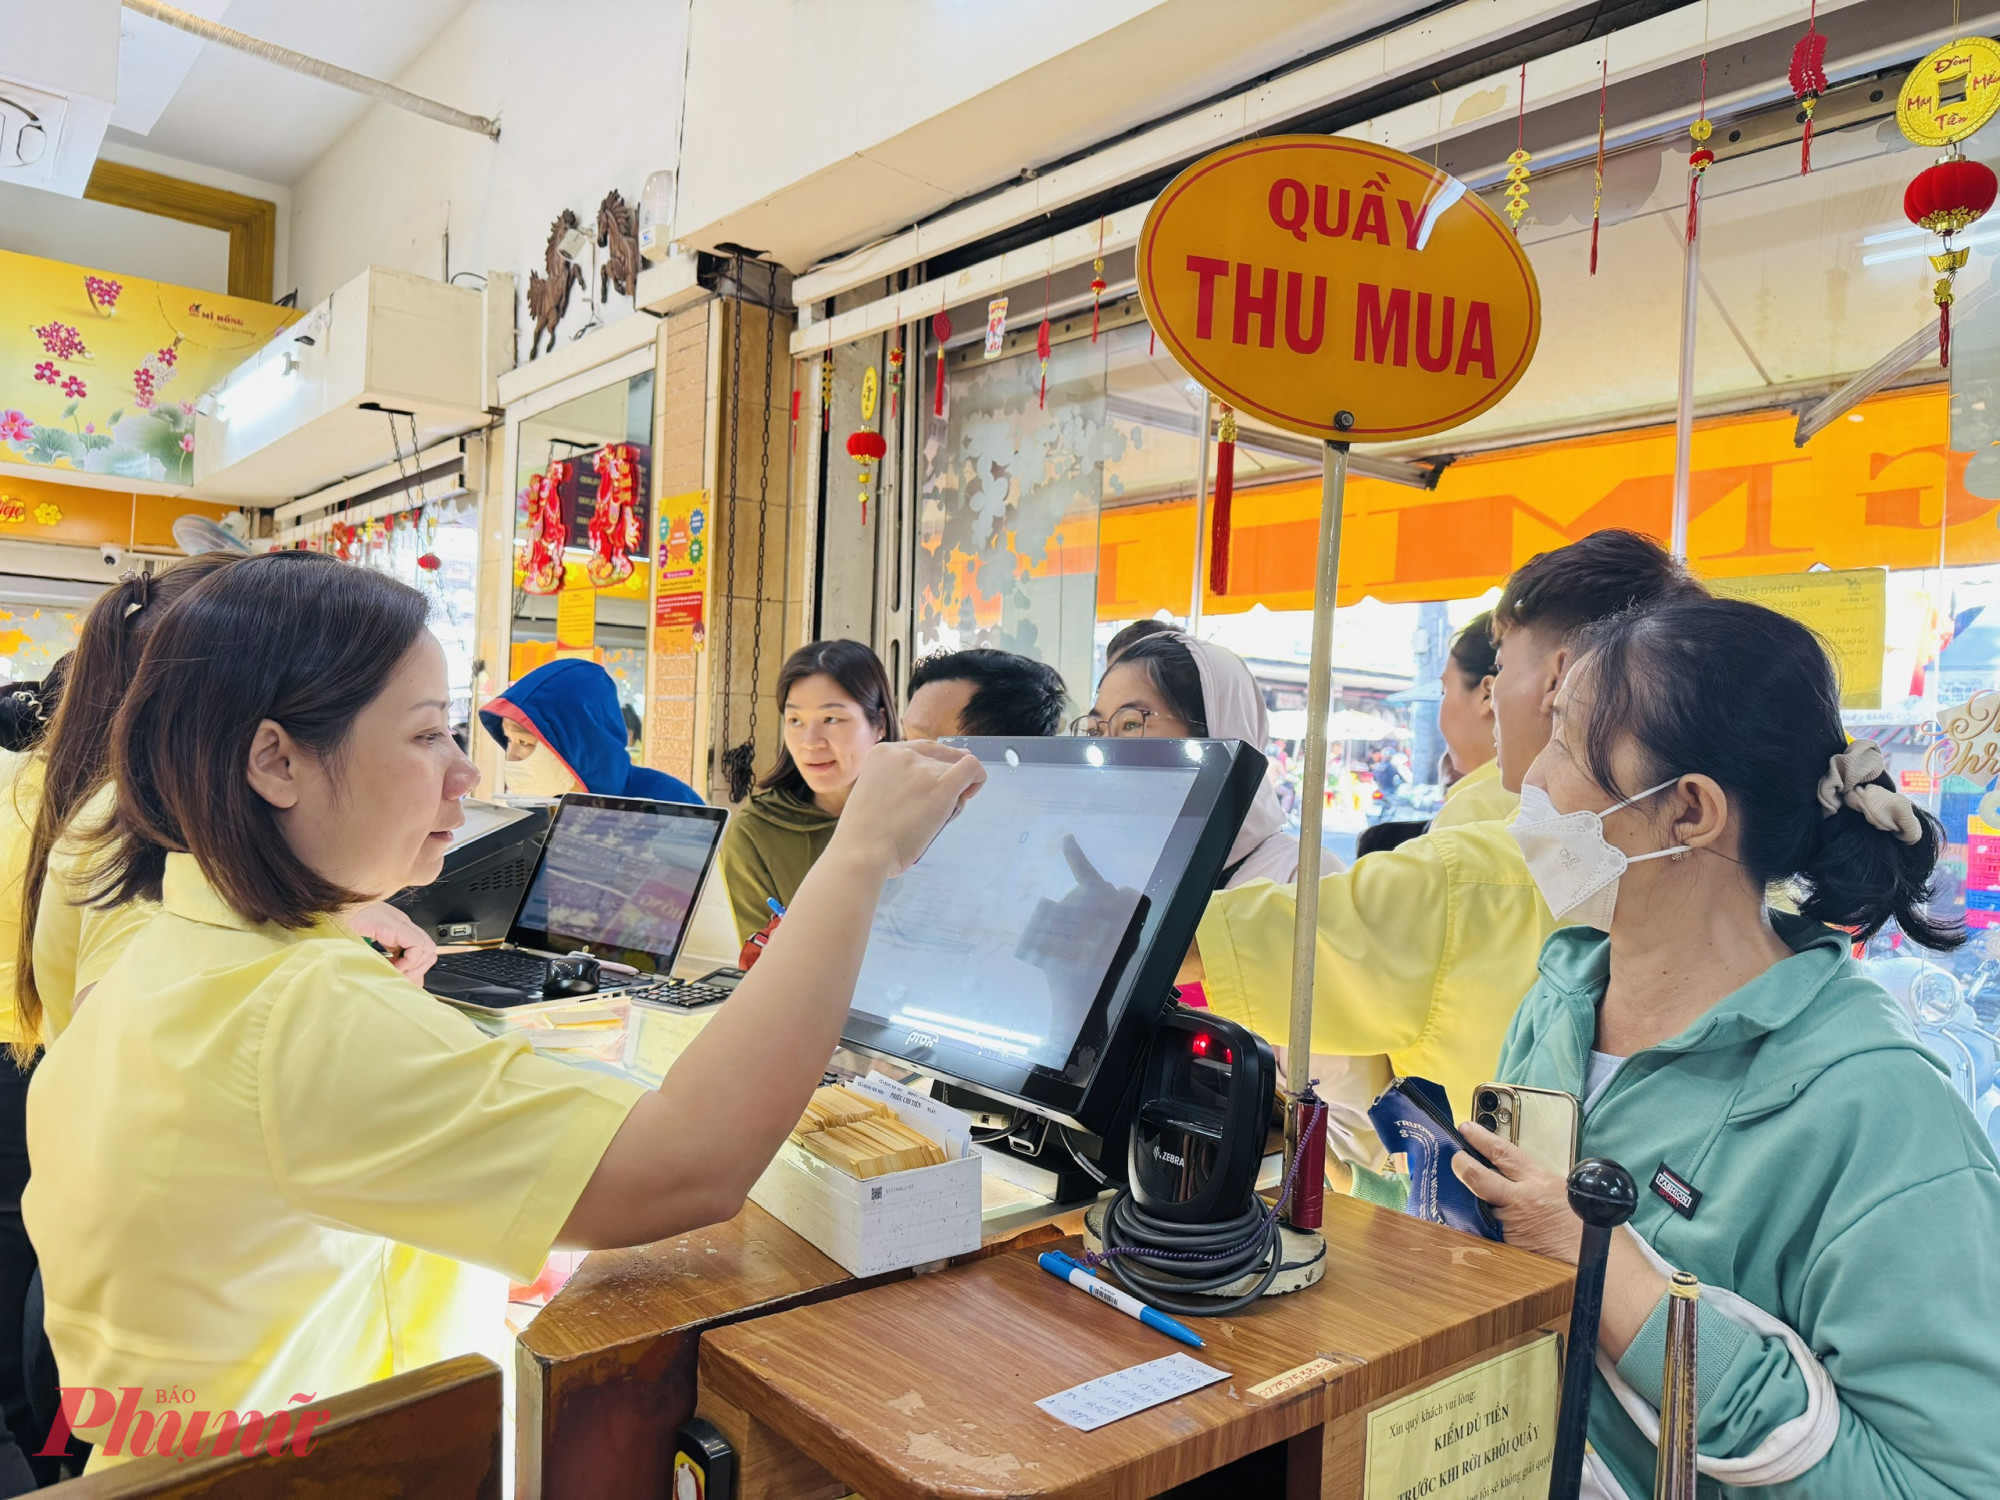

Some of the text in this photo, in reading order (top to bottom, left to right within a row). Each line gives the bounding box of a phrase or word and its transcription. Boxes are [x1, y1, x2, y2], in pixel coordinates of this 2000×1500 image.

[1268, 171, 1429, 252] QUẦY
[1186, 254, 1497, 379] THU MUA
[1162, 1151, 1185, 1168] ZEBRA
[1658, 1176, 1689, 1204] FASHION
[1658, 1188, 1681, 1208] SPORT
[1389, 1390, 1477, 1439] Xin quý khách vui lòng:
[1434, 1401, 1510, 1452] KIỂM ĐỦ TIỀN
[1439, 1464, 1460, 1488] KHI
[1462, 1453, 1481, 1477] RỜI
[1483, 1437, 1510, 1465] KHỎI
[1511, 1422, 1540, 1452] QUẦY
[1500, 1471, 1521, 1492] không
